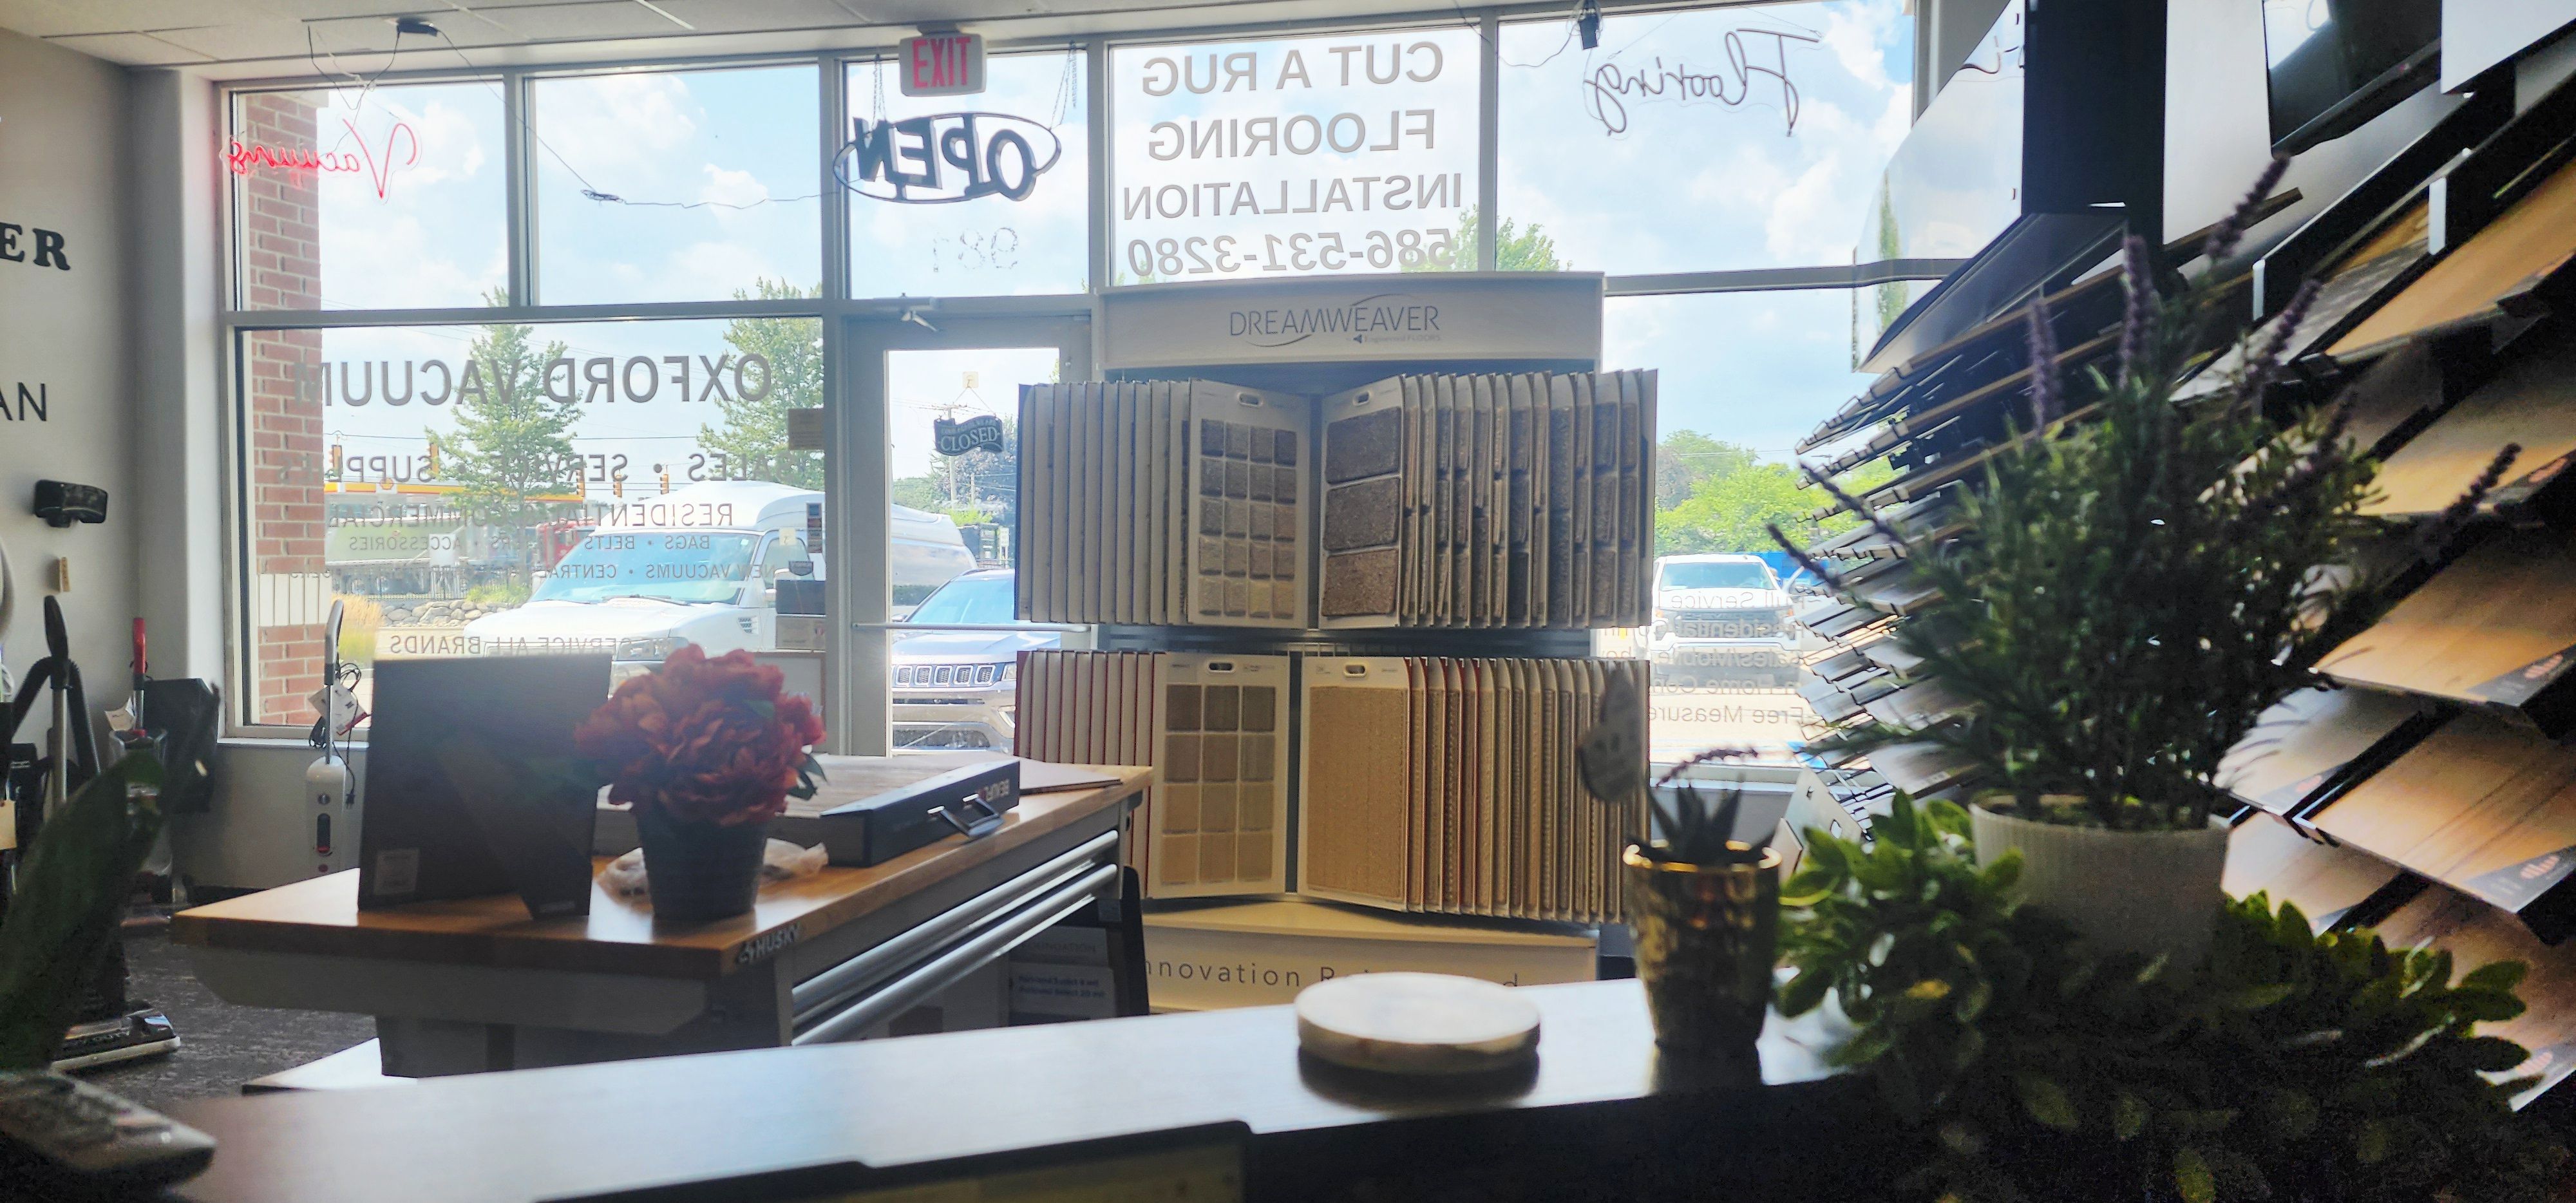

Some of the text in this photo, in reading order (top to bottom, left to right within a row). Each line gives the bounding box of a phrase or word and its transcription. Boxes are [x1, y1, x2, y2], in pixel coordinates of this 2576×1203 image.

[912, 36, 971, 89] EXIT
[1229, 305, 1441, 337] DREAMWEAVER
[940, 426, 998, 451] CLOSED
[1145, 958, 1300, 987] nnovation
